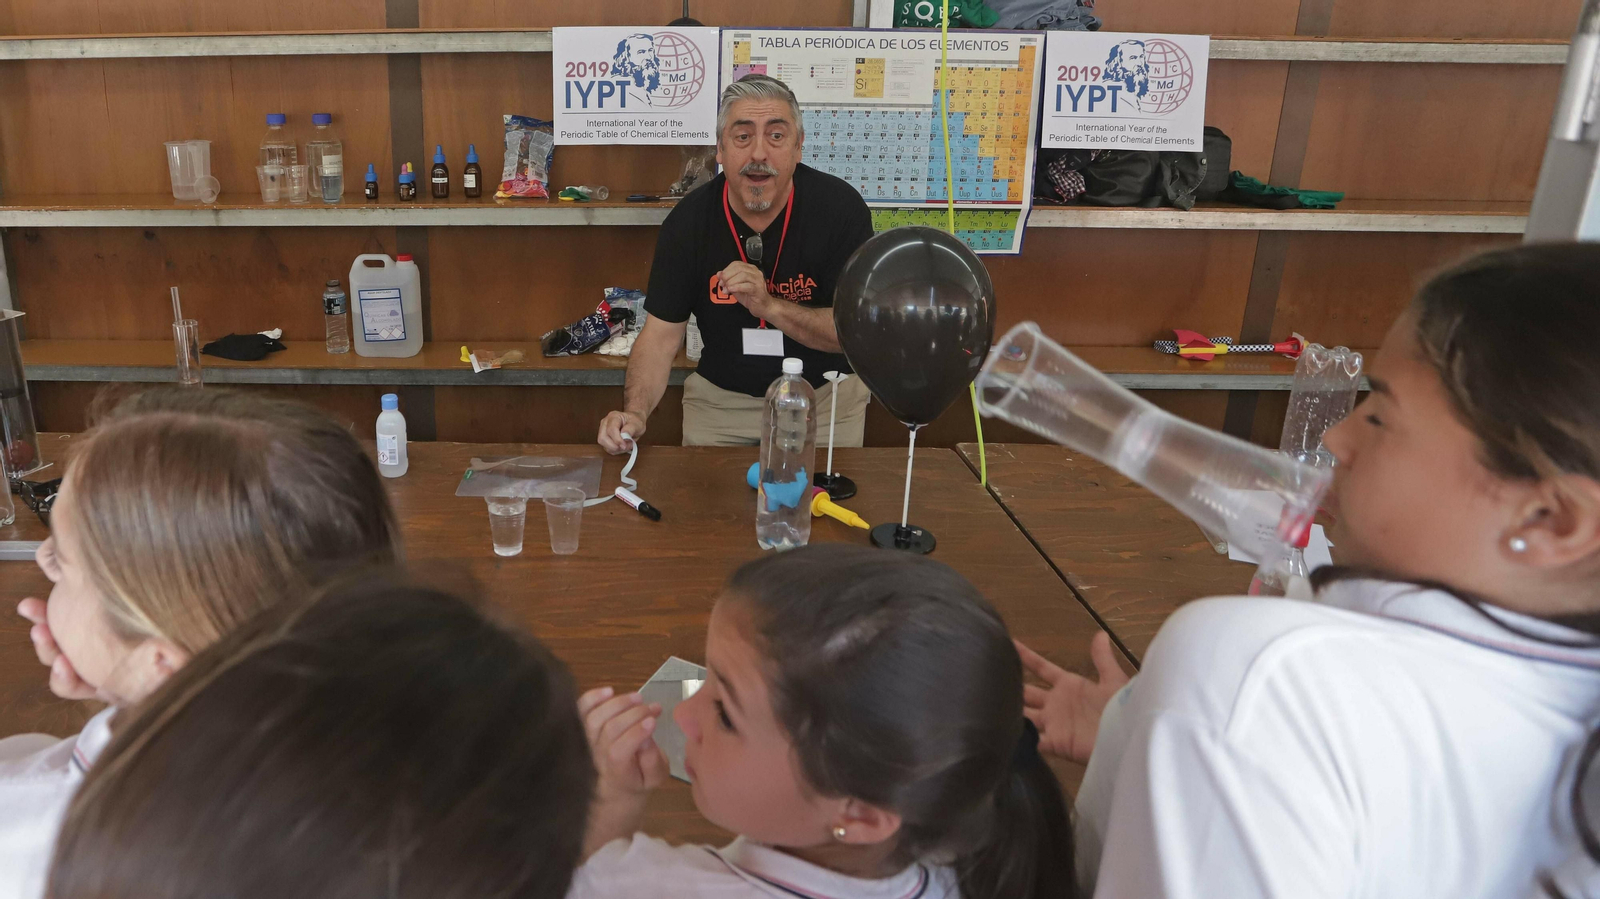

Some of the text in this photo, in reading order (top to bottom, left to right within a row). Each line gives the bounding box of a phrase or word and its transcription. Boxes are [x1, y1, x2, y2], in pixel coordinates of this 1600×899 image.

[758, 36, 1009, 51] TABLA PERIÓDICA DE LOS ELEMENTOS
[566, 62, 609, 78] 2019
[1058, 66, 1101, 82] 2019
[669, 73, 686, 82] Md
[856, 78, 867, 89] Si
[1157, 80, 1174, 89] Md
[566, 81, 630, 108] IYPT
[681, 86, 688, 94] H
[1056, 84, 1122, 112] IYPT
[560, 130, 594, 138] Periodic
[1076, 124, 1126, 132] International
[1129, 125, 1145, 133] Year
[1049, 134, 1082, 142] Periodic
[1085, 134, 1108, 142] Table
[1120, 135, 1153, 144] Chemical
[1155, 137, 1194, 145] Elements
